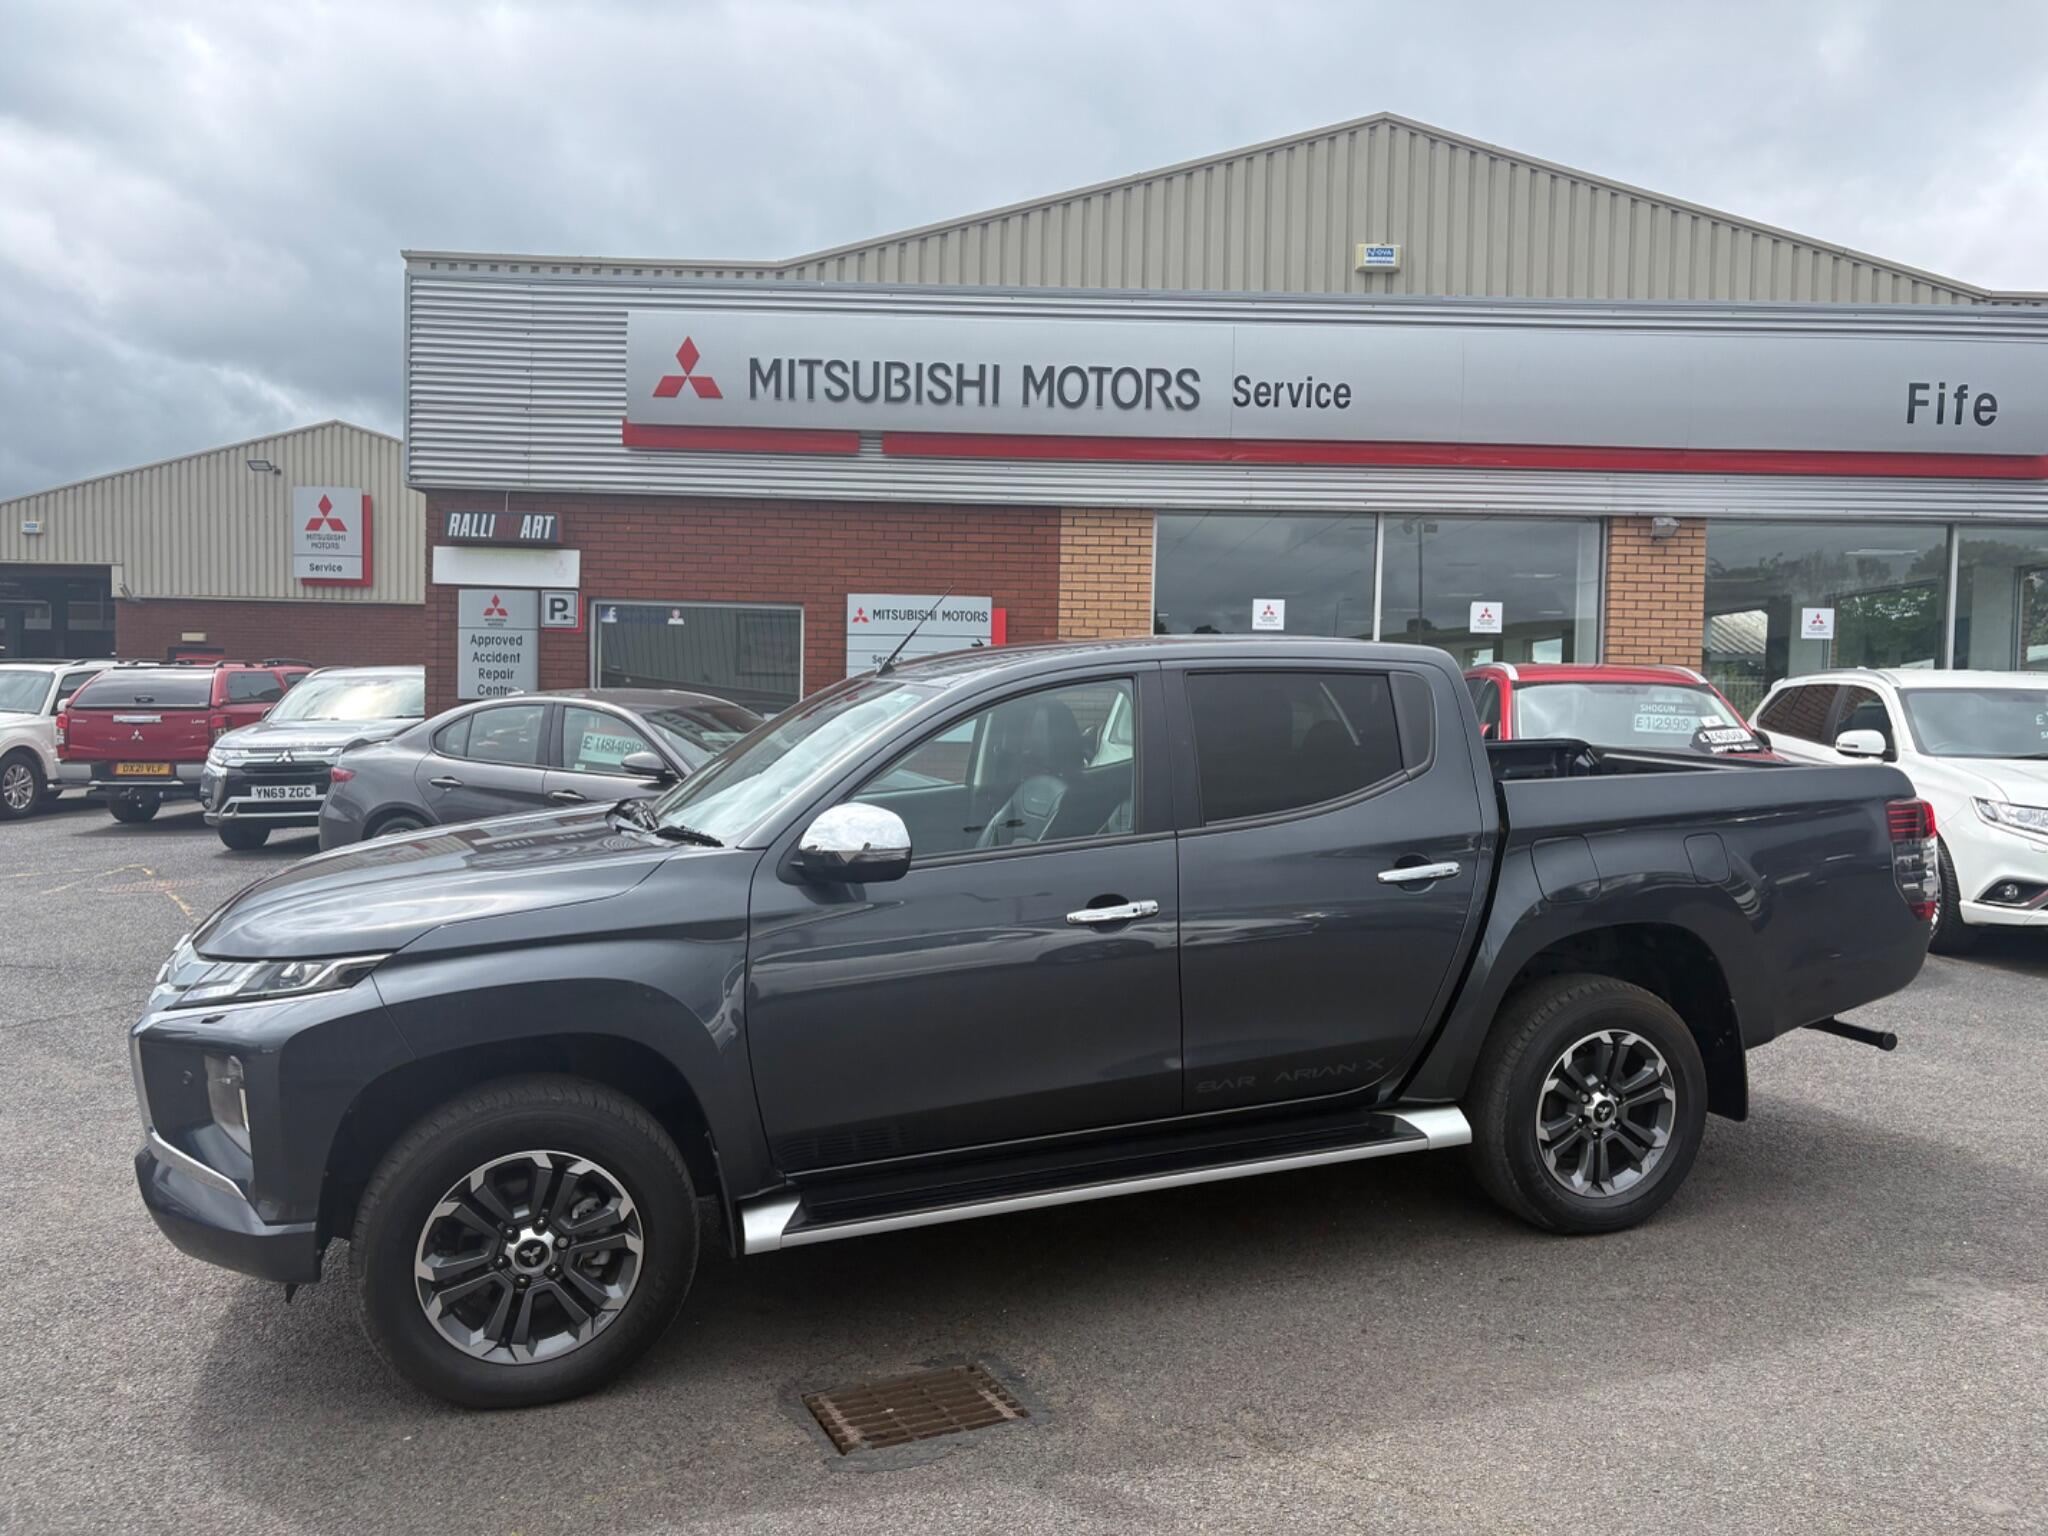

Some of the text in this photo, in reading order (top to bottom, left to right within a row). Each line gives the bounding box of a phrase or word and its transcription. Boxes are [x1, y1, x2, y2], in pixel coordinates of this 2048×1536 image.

[749, 357, 1352, 411] MITSUBISHI MOTORS Service
[1907, 382, 1998, 426] Fife
[448, 513, 555, 539] RALLI ART
[309, 563, 343, 572] Service
[550, 598, 568, 620] P
[872, 609, 988, 623] MITSUBISHI MOTORS
[470, 634, 523, 647] Approved
[472, 651, 521, 663] Accident
[478, 668, 514, 681] Repair
[1640, 704, 1676, 713] SHOGUN
[256, 787, 311, 798] YN69 ZGC
